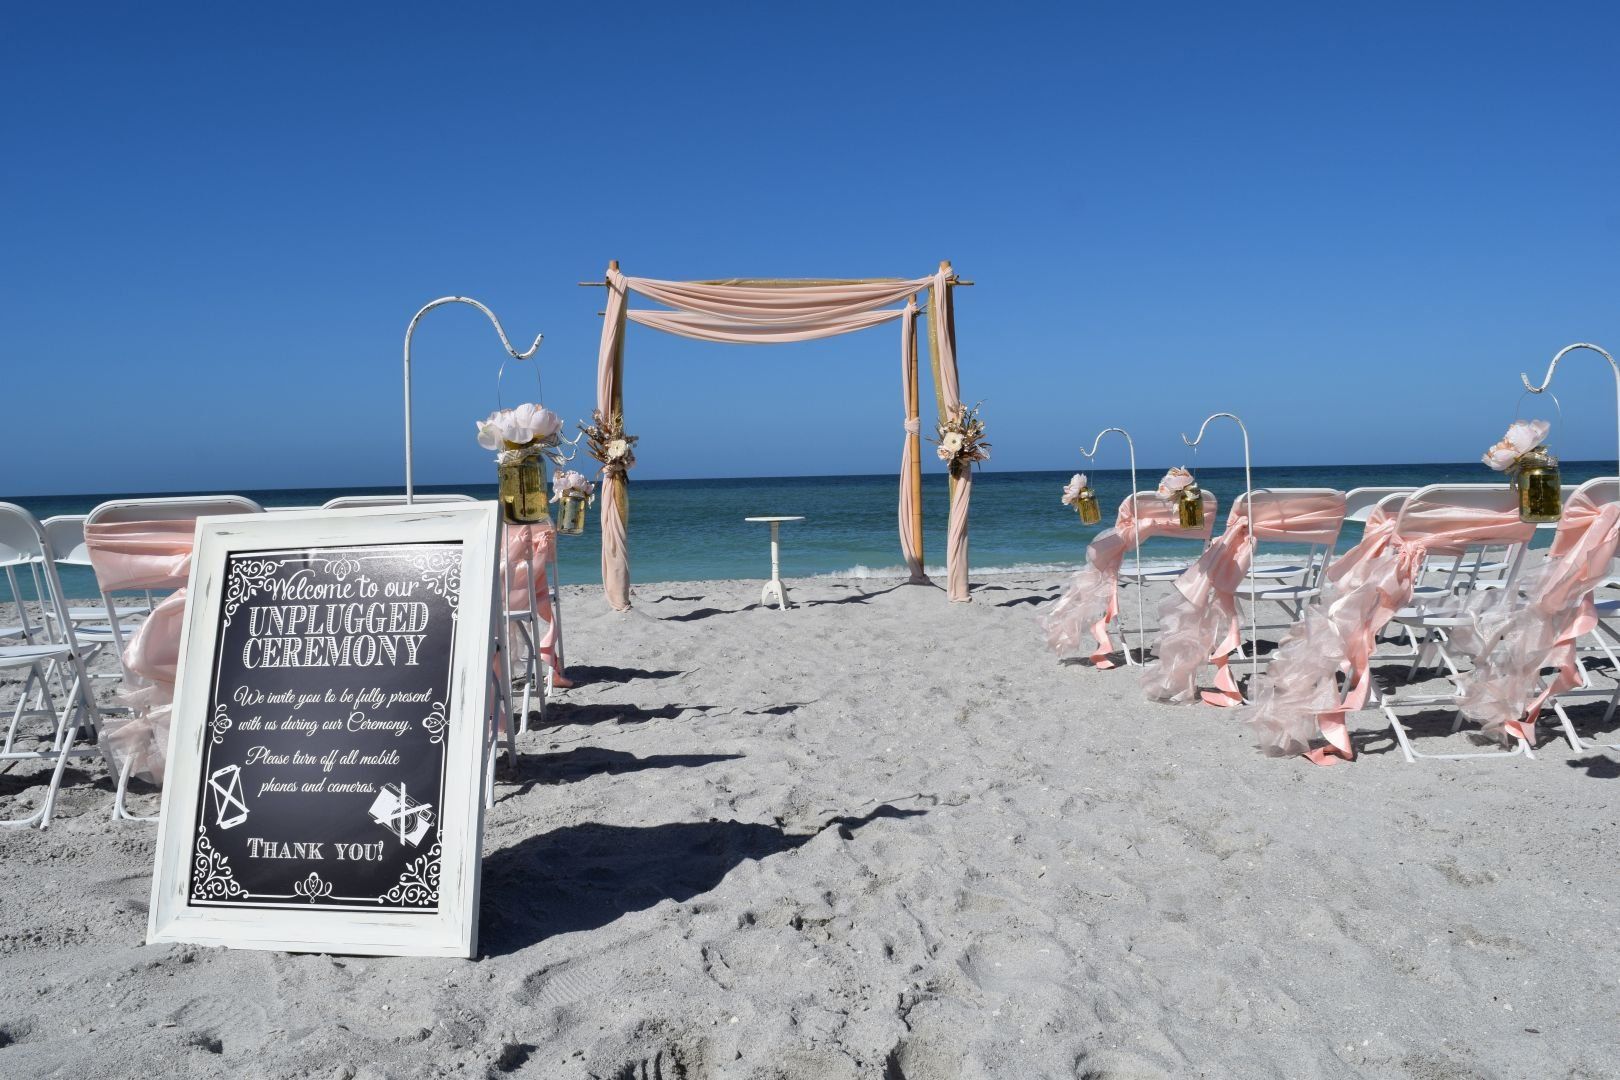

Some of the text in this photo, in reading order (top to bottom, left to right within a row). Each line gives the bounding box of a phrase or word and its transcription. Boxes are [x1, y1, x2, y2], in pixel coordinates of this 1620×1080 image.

[264, 569, 419, 600] Welcome to our
[249, 602, 428, 636] UNPLUGGED
[243, 635, 427, 668] CEREMONY
[234, 686, 432, 709] We invite you to be fully present
[239, 712, 412, 736] with us during our Ceremony.
[246, 746, 399, 772] Please turn off all mobile
[257, 777, 376, 797] phones and cameras.
[247, 838, 384, 861] THANK YOU!
